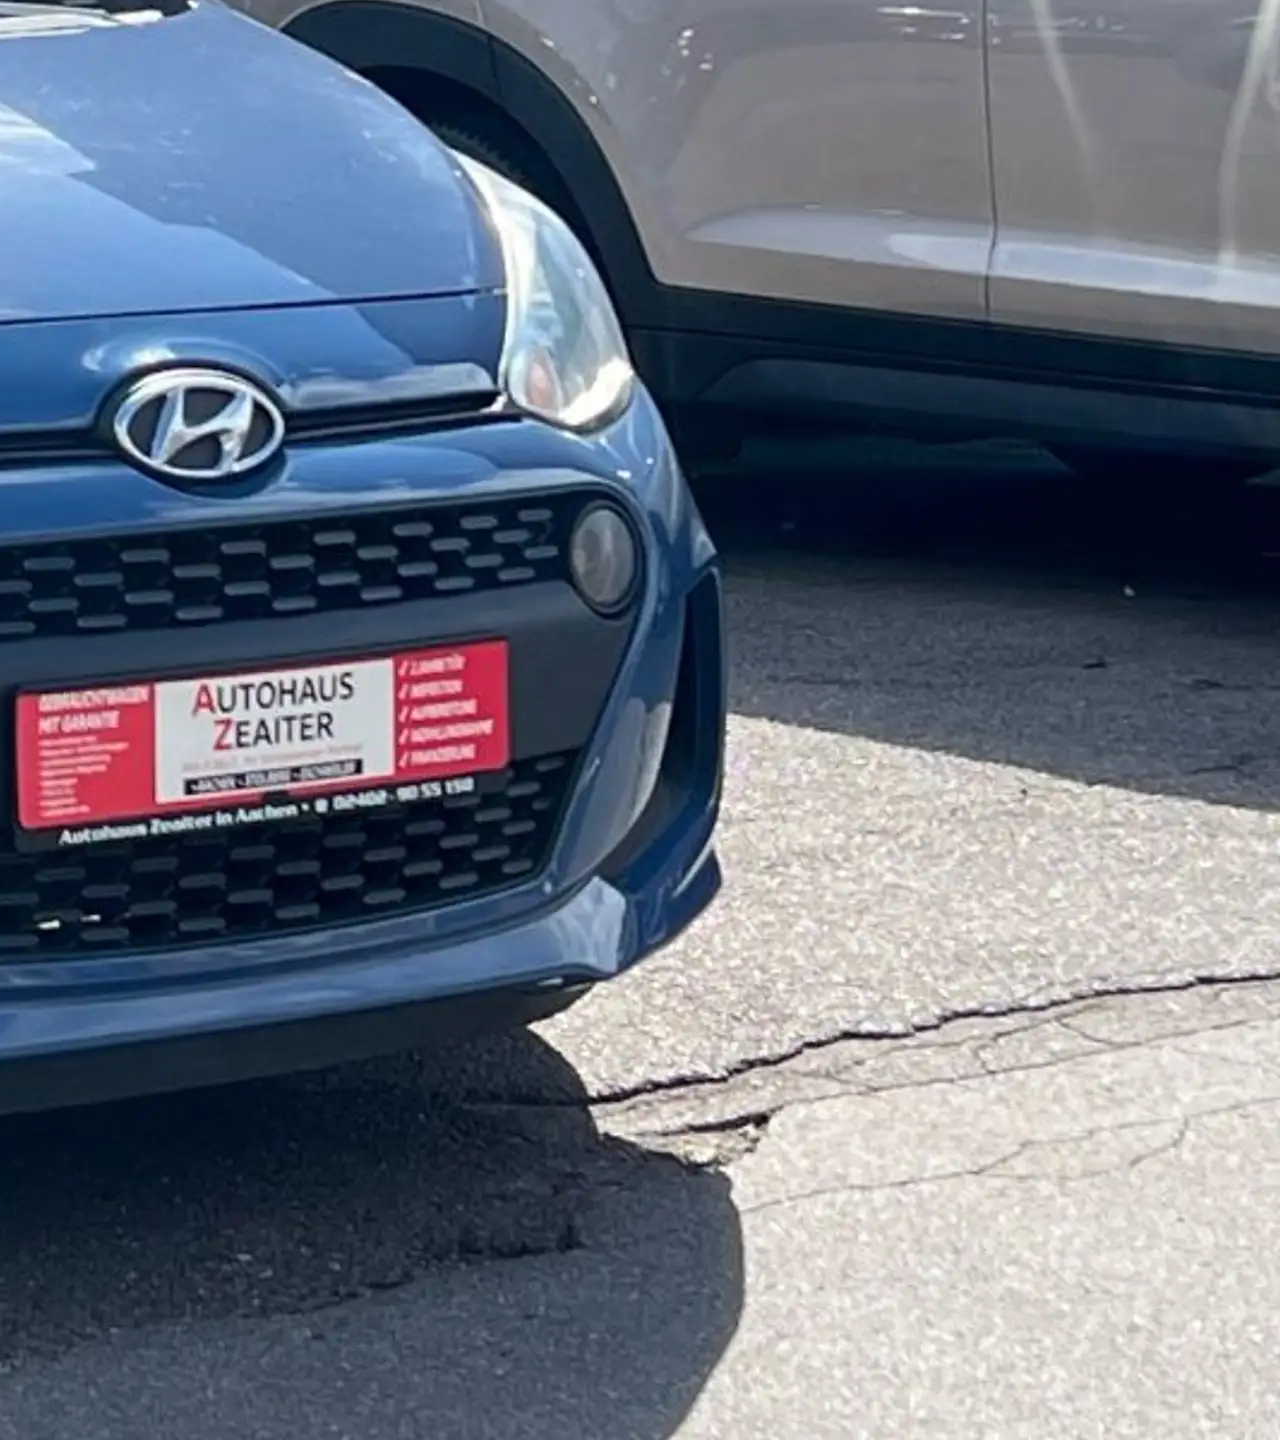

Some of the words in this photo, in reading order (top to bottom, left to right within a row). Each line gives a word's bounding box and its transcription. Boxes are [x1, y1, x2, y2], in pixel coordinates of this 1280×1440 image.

[192, 672, 354, 717] AUTOHAUS
[213, 712, 334, 751] ZEAITER
[59, 822, 147, 846] Autohaus
[149, 815, 213, 835] Zeaiter
[216, 810, 233, 826] in
[236, 803, 298, 824] Aachen
